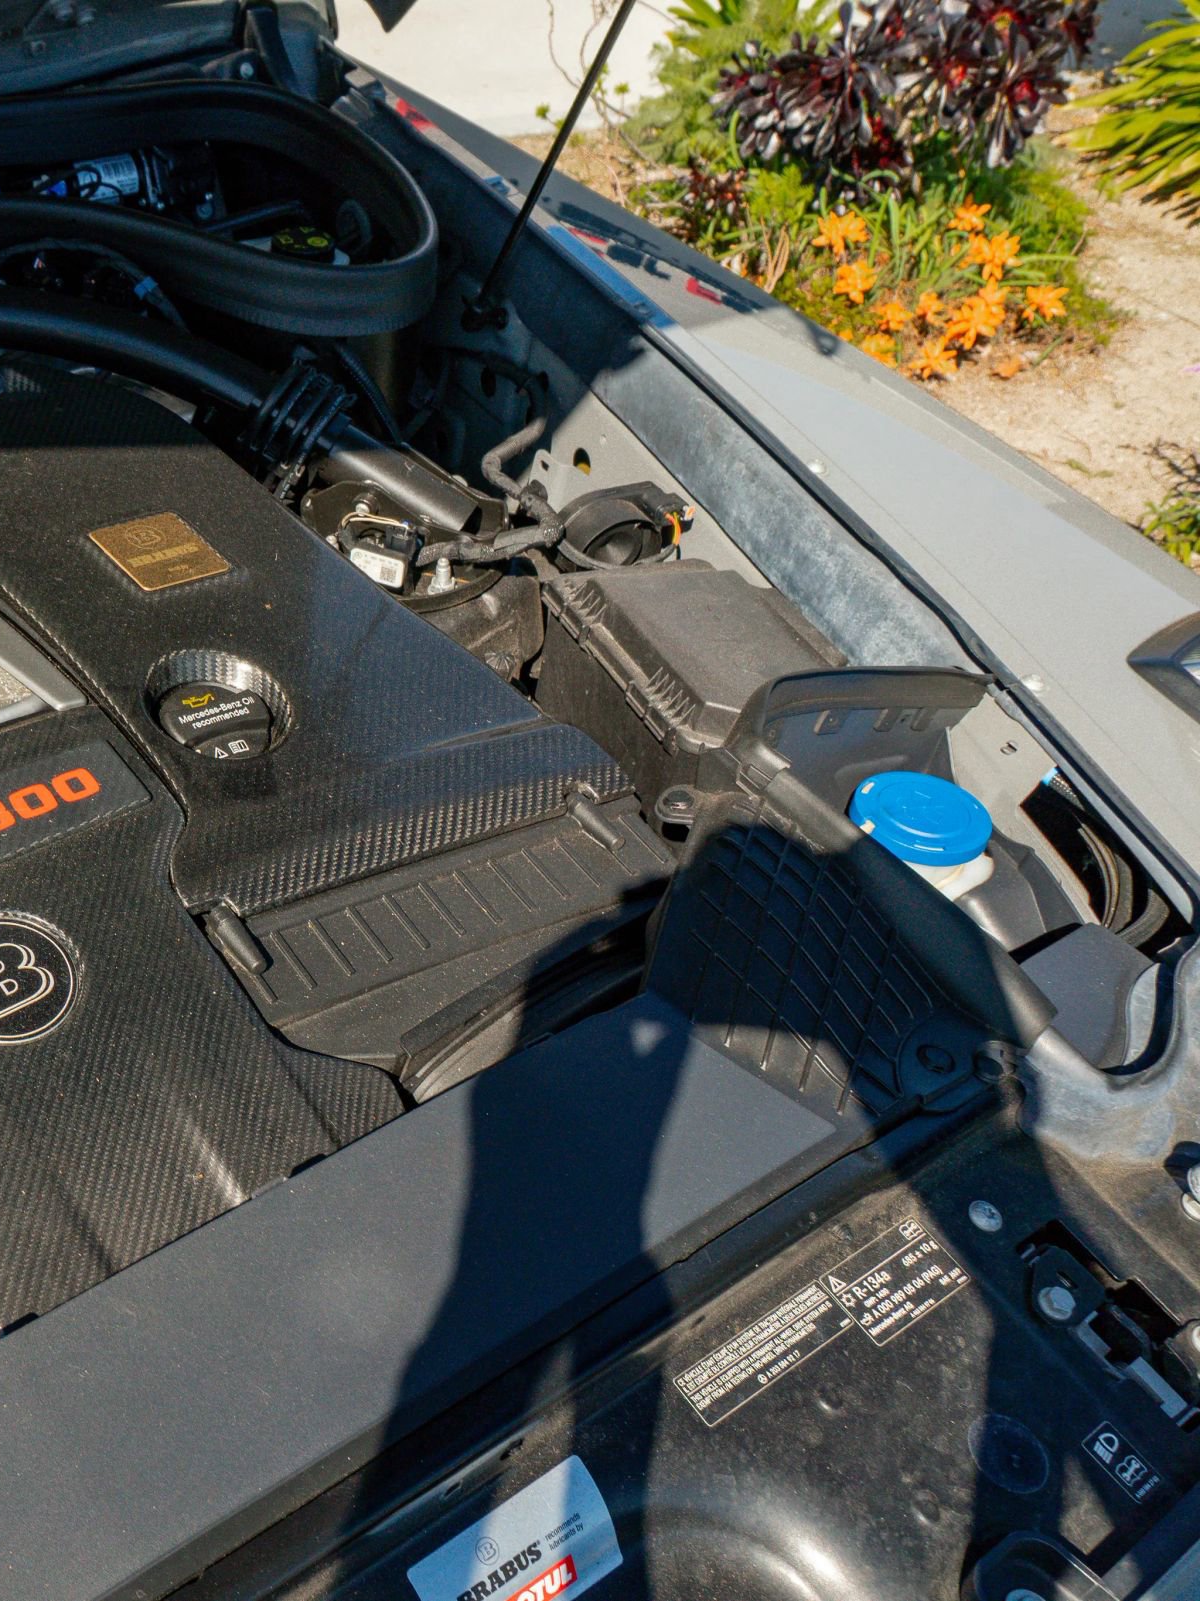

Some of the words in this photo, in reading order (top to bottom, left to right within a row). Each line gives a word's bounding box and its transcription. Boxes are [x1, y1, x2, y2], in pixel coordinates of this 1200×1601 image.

[178, 700, 242, 724] Mercedes-Benz
[241, 696, 255, 705] Oil
[191, 707, 250, 729] recommended
[902, 1253, 917, 1266] 685
[920, 1243, 931, 1253] 10
[929, 1241, 938, 1249] g
[852, 1271, 891, 1299] R-134a
[872, 1309, 882, 1318] A
[877, 1300, 894, 1313] 000
[890, 1290, 906, 1304] 989
[903, 1283, 915, 1295] 05
[912, 1277, 925, 1288] 06
[921, 1265, 943, 1283] (PAG)
[904, 1301, 914, 1311] AG
[545, 1512, 581, 1541] recommends
[549, 1526, 576, 1551] lubricants
[575, 1522, 584, 1533] by
